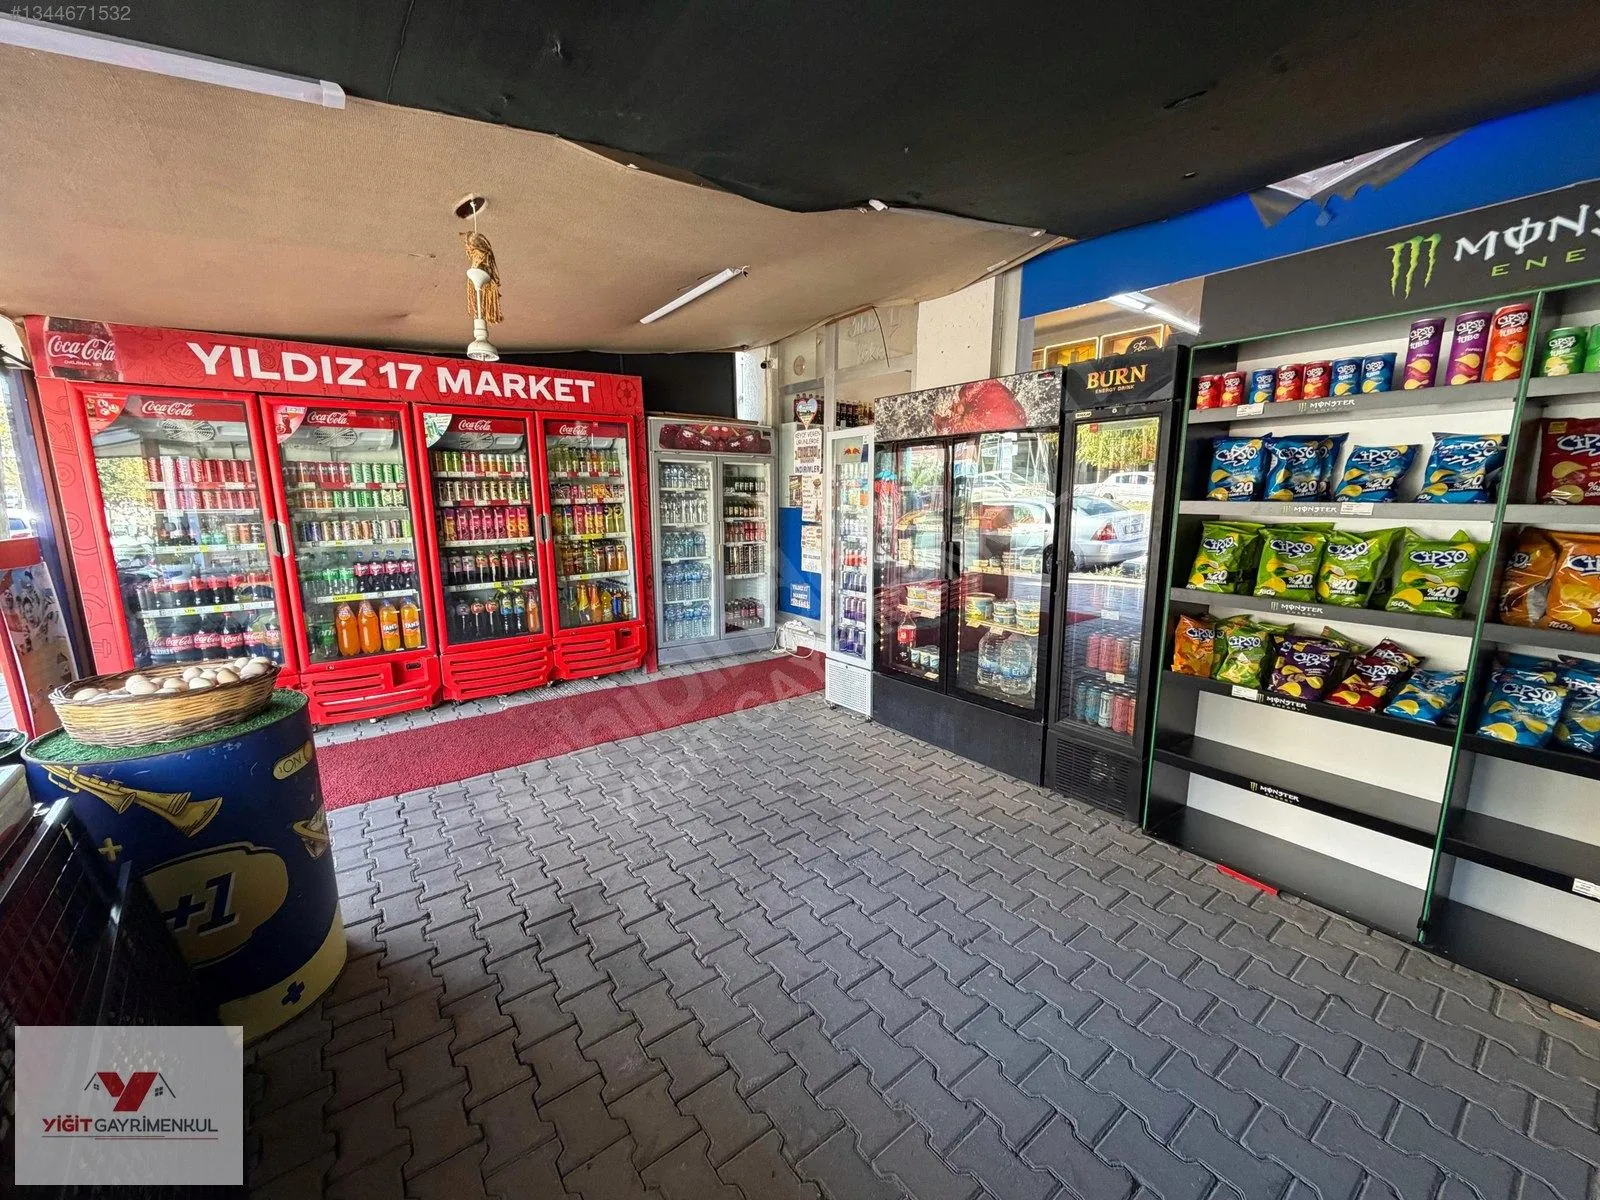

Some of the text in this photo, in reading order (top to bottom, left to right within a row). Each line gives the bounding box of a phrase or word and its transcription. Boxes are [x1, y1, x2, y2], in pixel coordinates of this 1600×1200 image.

[186, 341, 595, 404] YILDIZ 17 MARKET
[1086, 363, 1148, 390] BURN
